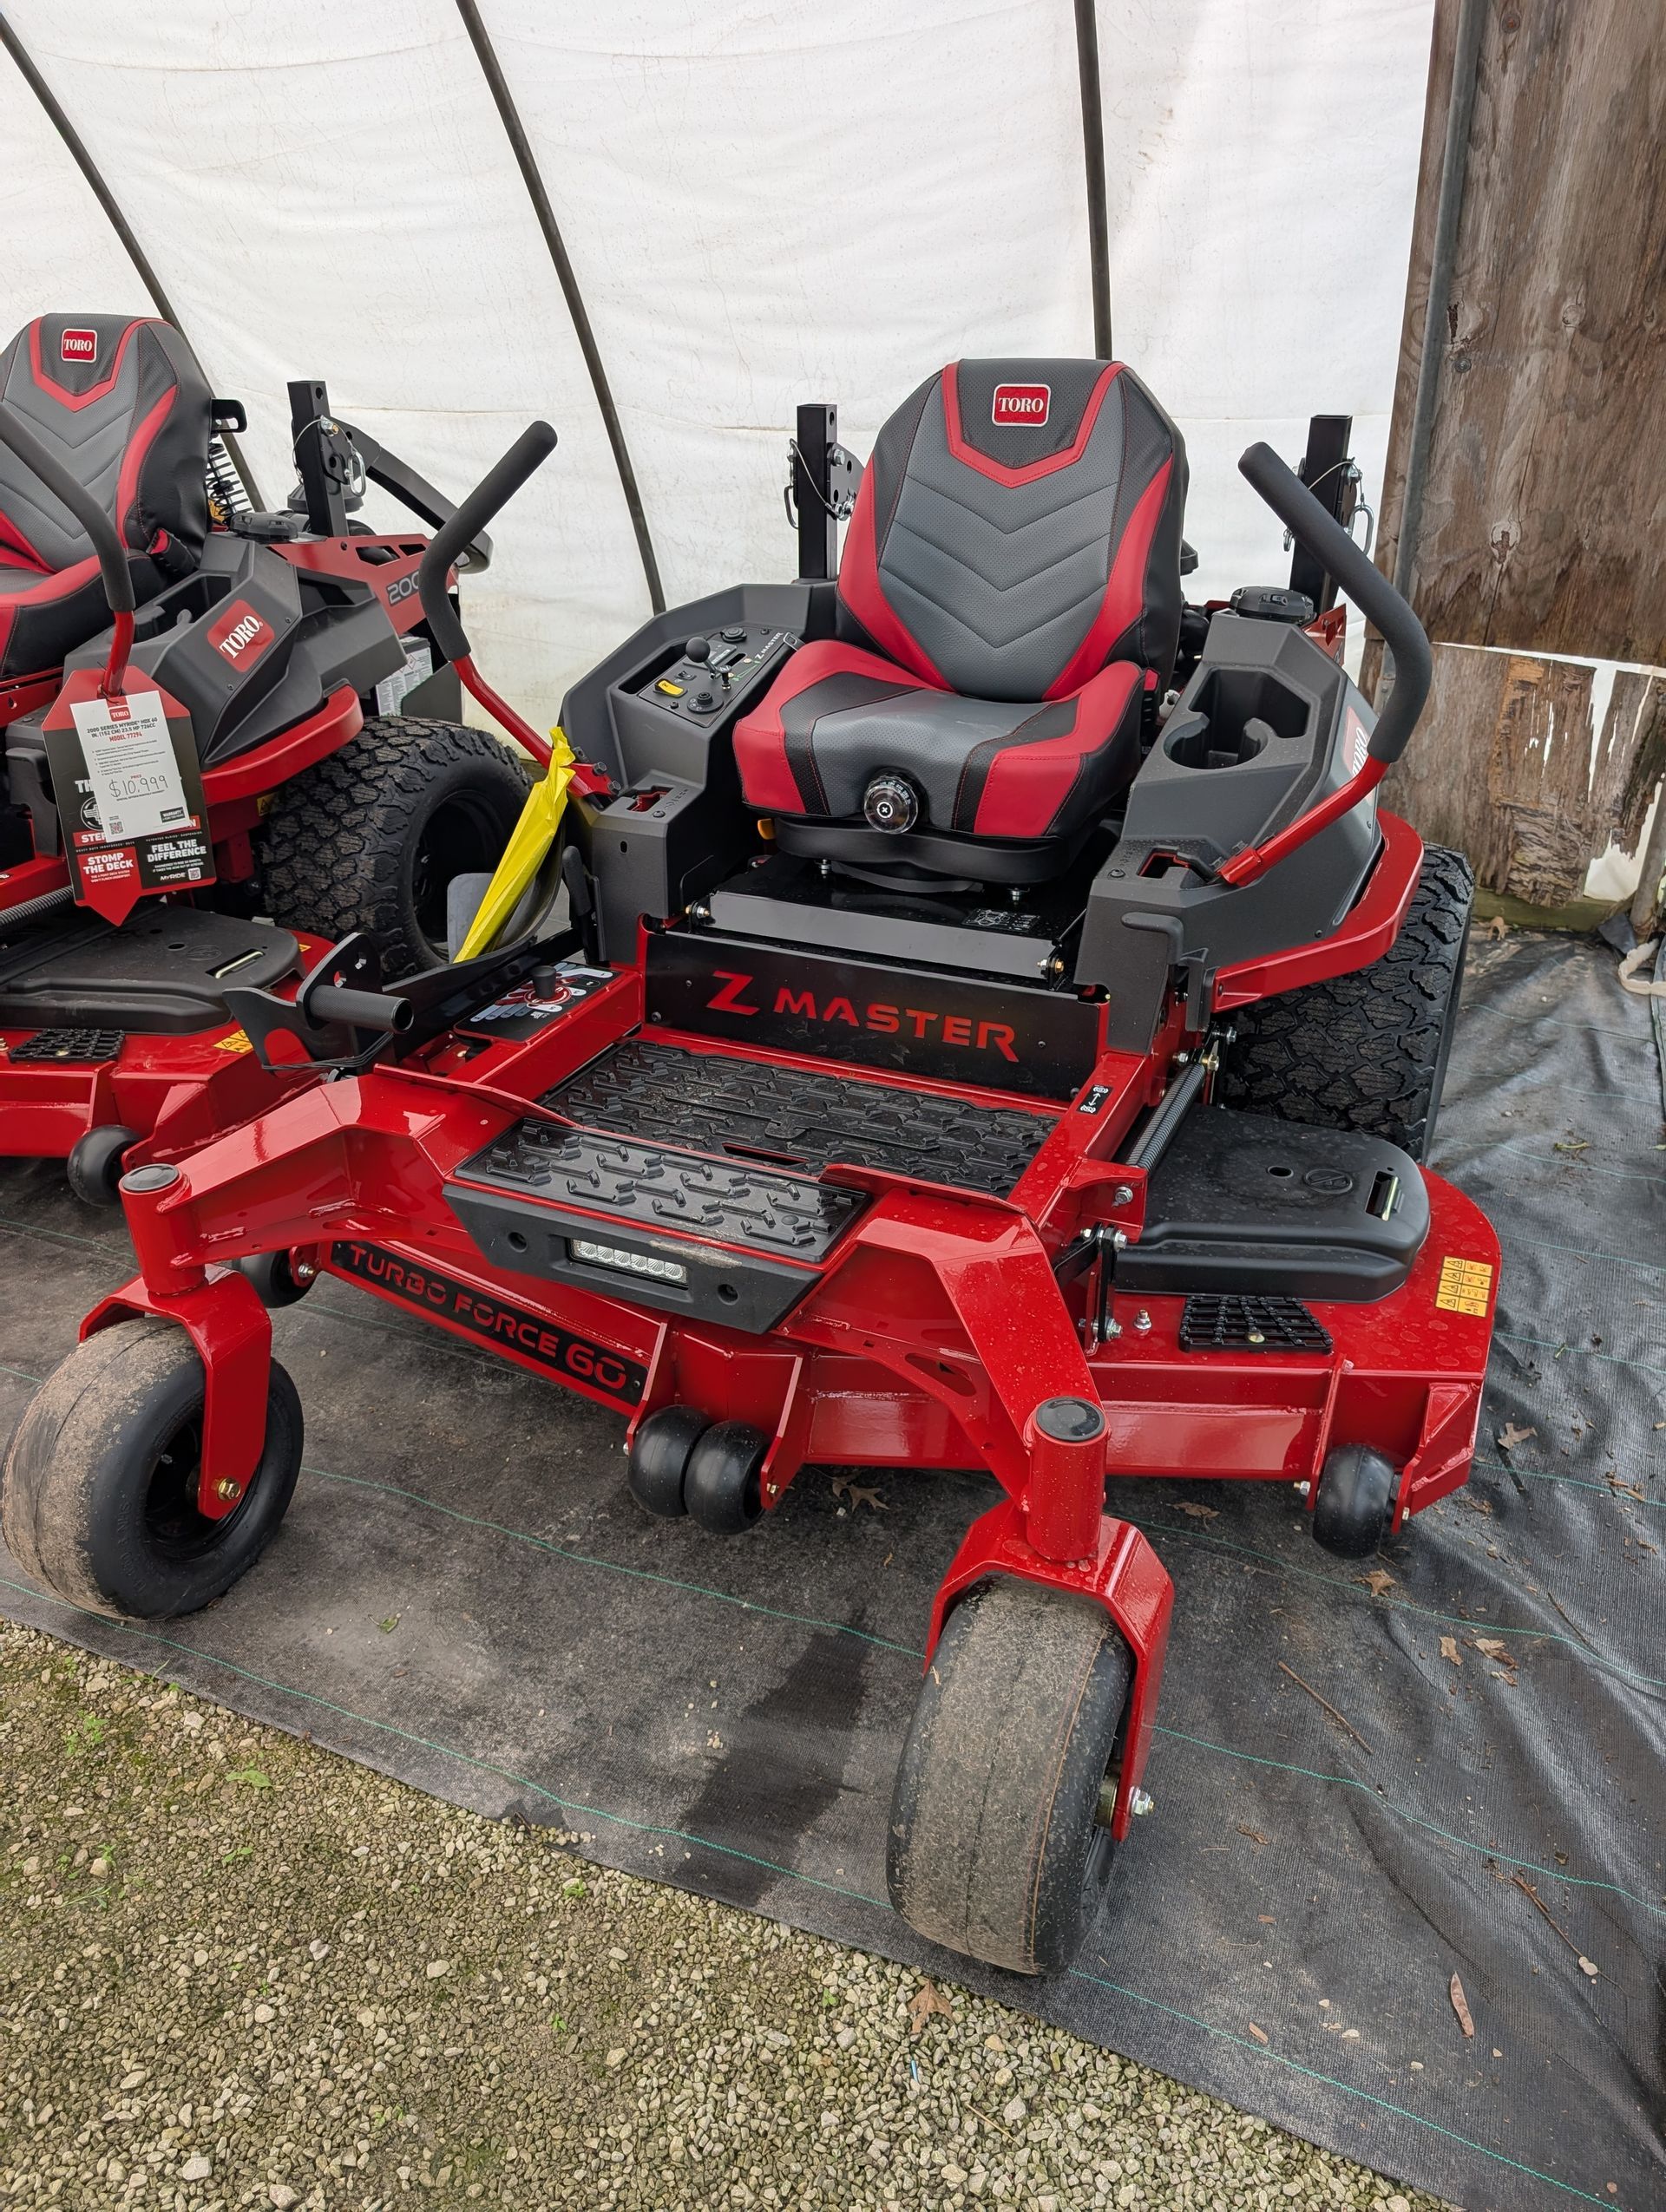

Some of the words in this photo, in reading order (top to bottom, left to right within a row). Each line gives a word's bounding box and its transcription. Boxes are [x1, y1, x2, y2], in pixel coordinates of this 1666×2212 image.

[63, 338, 93, 352] TORO
[998, 397, 1044, 413] TORO
[387, 571, 420, 605] 200
[147, 846, 207, 863] DIFFERENCE
[151, 842, 176, 854] FEEL
[176, 839, 198, 849] THE
[82, 864, 105, 874] THE
[106, 859, 134, 871] DECK
[88, 852, 124, 866] STOMP
[705, 970, 761, 1016] Z
[773, 987, 1020, 1063] MASTER
[350, 1244, 447, 1305] TURBO
[453, 1296, 560, 1358] FORCE
[565, 1343, 626, 1389] 60
